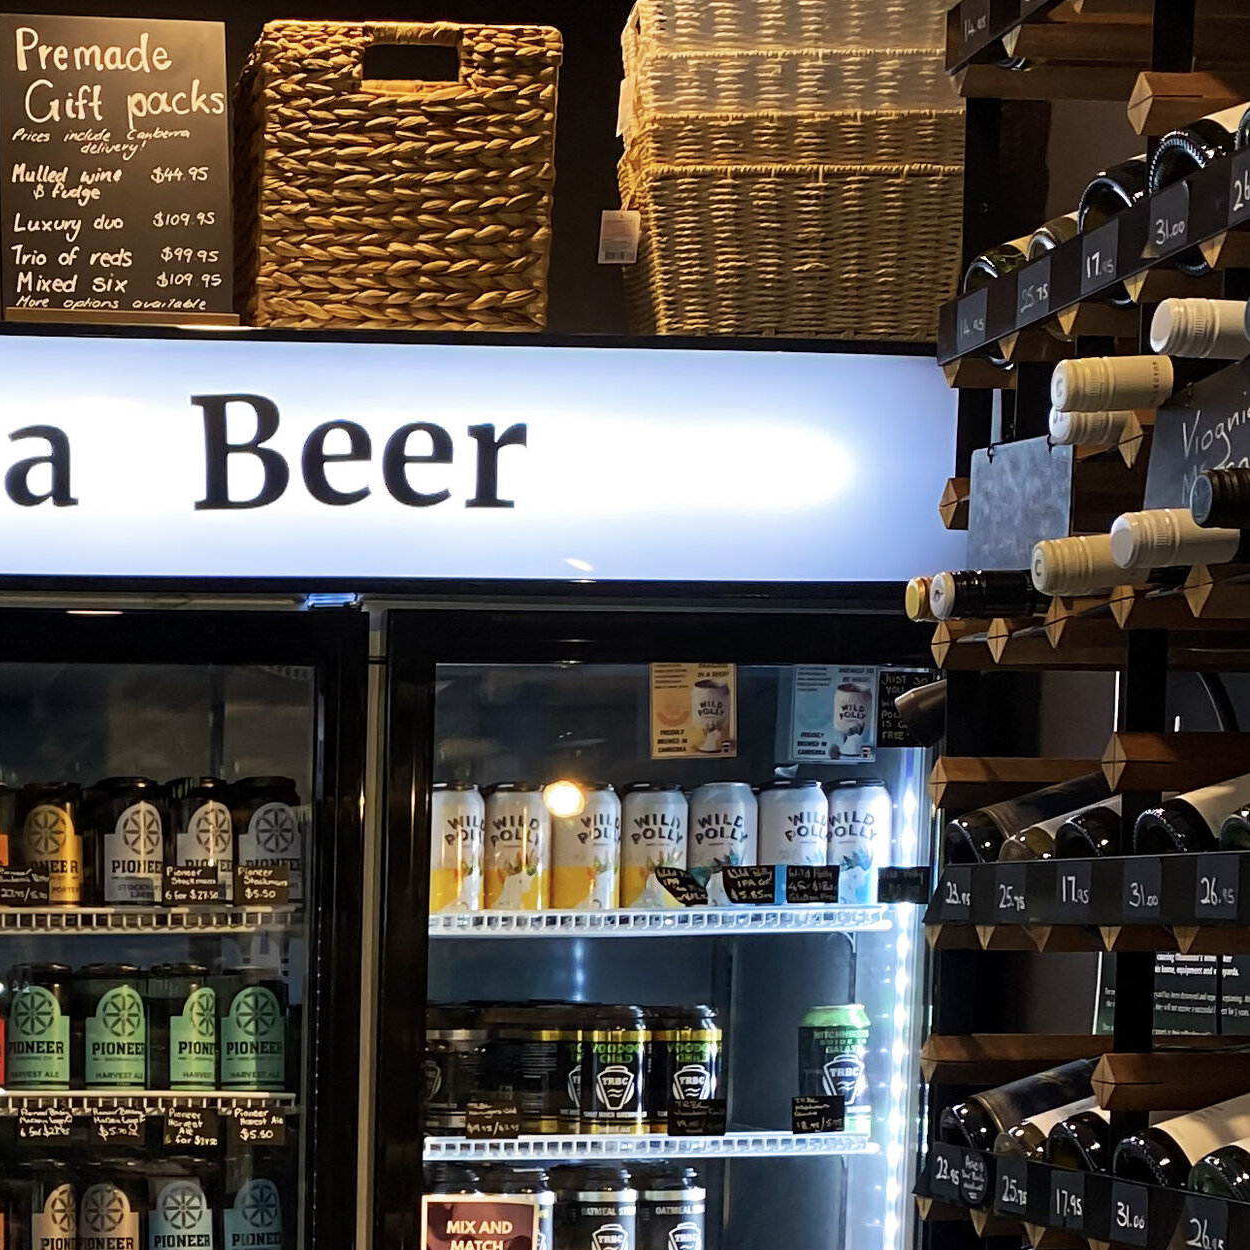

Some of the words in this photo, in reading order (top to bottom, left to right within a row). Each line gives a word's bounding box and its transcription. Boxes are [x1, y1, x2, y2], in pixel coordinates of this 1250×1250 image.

[15, 26, 173, 73] Premade
[24, 79, 103, 123] Gift
[127, 79, 225, 129] packs
[11, 128, 51, 143] Prices
[63, 128, 111, 142] include
[127, 127, 190, 142] Canberra
[80, 140, 147, 161] delivery!
[11, 163, 67, 184] Mulled
[80, 167, 123, 183] wine
[151, 166, 209, 184] $44.95
[51, 185, 101, 207] fudge
[13, 213, 82, 242] Luxury
[94, 214, 124, 230] duo
[153, 212, 216, 228] $109.95
[1155, 219, 1185, 245] 31.00
[11, 244, 47, 266] Trio
[58, 246, 79, 266] of
[90, 248, 133, 268] reds
[161, 247, 220, 263] $99.95
[16, 271, 78, 293] Mixed
[92, 273, 127, 293] six
[156, 272, 222, 287] $109.95
[15, 296, 49, 309] More
[63, 297, 119, 310] options
[132, 298, 207, 310] available
[190, 391, 530, 511] Beer
[698, 708, 725, 717] POLLY
[699, 701, 723, 710] WILD
[841, 704, 865, 713] WILD
[634, 813, 680, 829] WILD
[698, 812, 744, 828] WILD
[630, 827, 683, 845] POLLY
[695, 827, 748, 845] POLLY
[602, 1076, 628, 1086] TRBC
[679, 1076, 706, 1086] TRBC
[446, 1220, 477, 1234] MIX
[478, 1220, 513, 1234] AND
[153, 1234, 210, 1250] PIONEER
